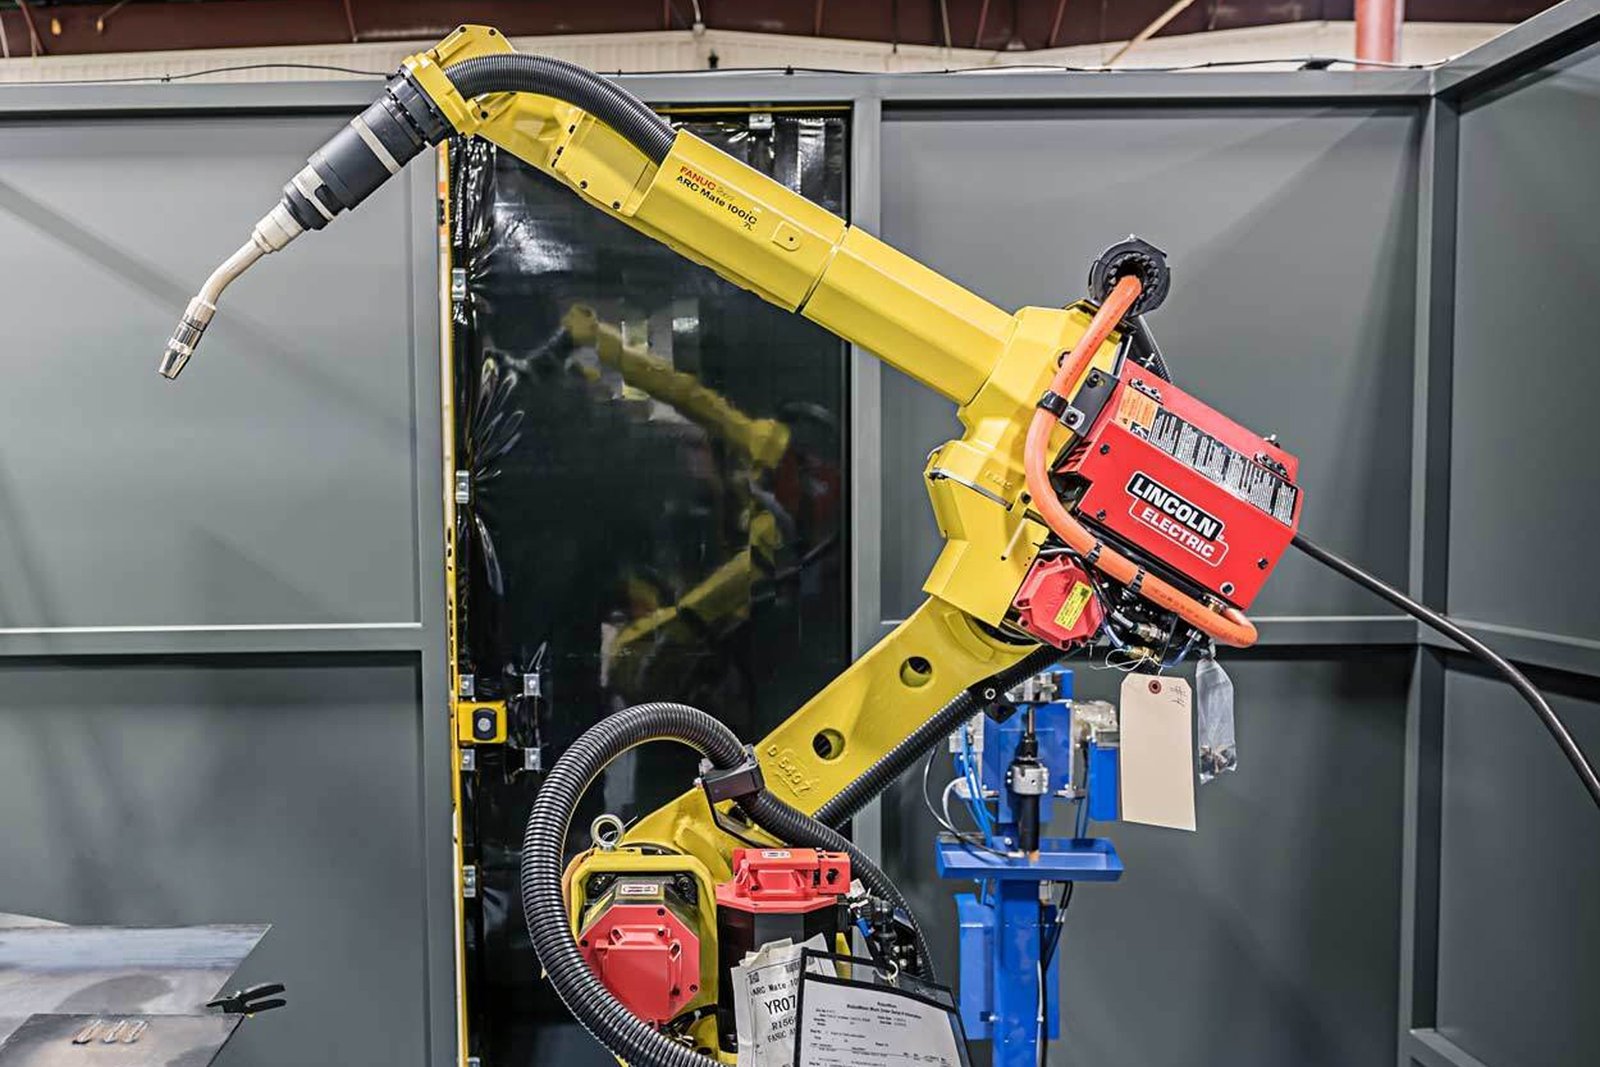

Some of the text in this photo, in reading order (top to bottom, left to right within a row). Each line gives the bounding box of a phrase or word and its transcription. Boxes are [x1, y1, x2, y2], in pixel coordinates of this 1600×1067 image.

[677, 175, 699, 191] ARC
[700, 188, 726, 207] Mate
[680, 166, 716, 190] FANUC
[1131, 477, 1218, 538] LINCOLN
[1140, 507, 1215, 558] ELECTRIC
[752, 986, 766, 995] ARC
[768, 982, 787, 991] Mate
